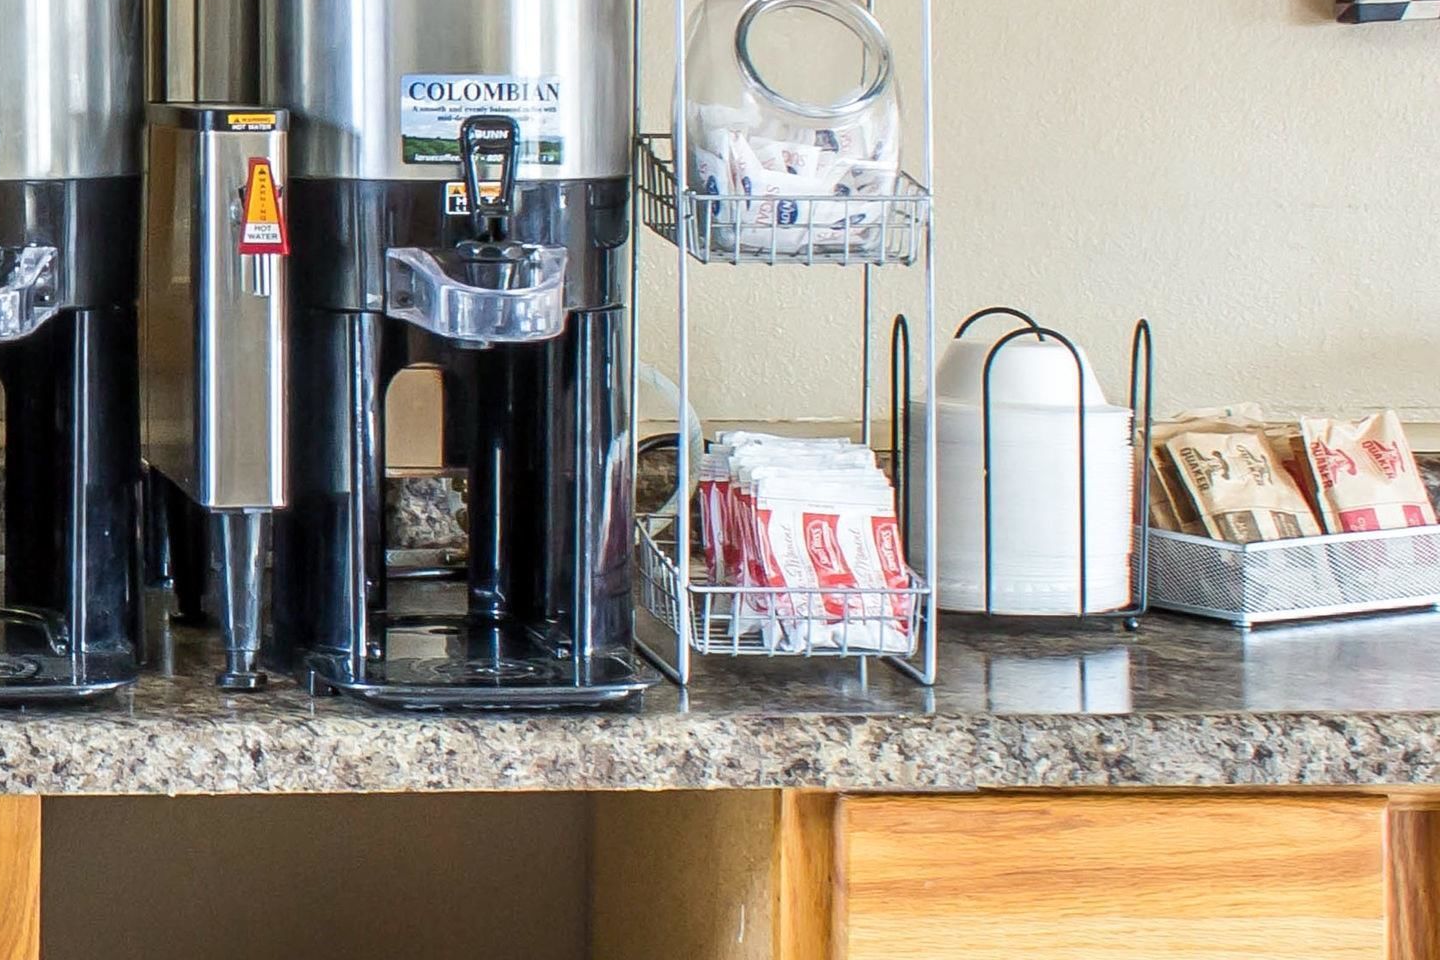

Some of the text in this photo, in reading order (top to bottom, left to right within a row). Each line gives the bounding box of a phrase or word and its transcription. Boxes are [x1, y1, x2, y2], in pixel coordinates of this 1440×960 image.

[409, 82, 561, 102] COLOMBIAN
[1179, 446, 1210, 491] QUAKER
[1310, 440, 1334, 490] QUAKER
